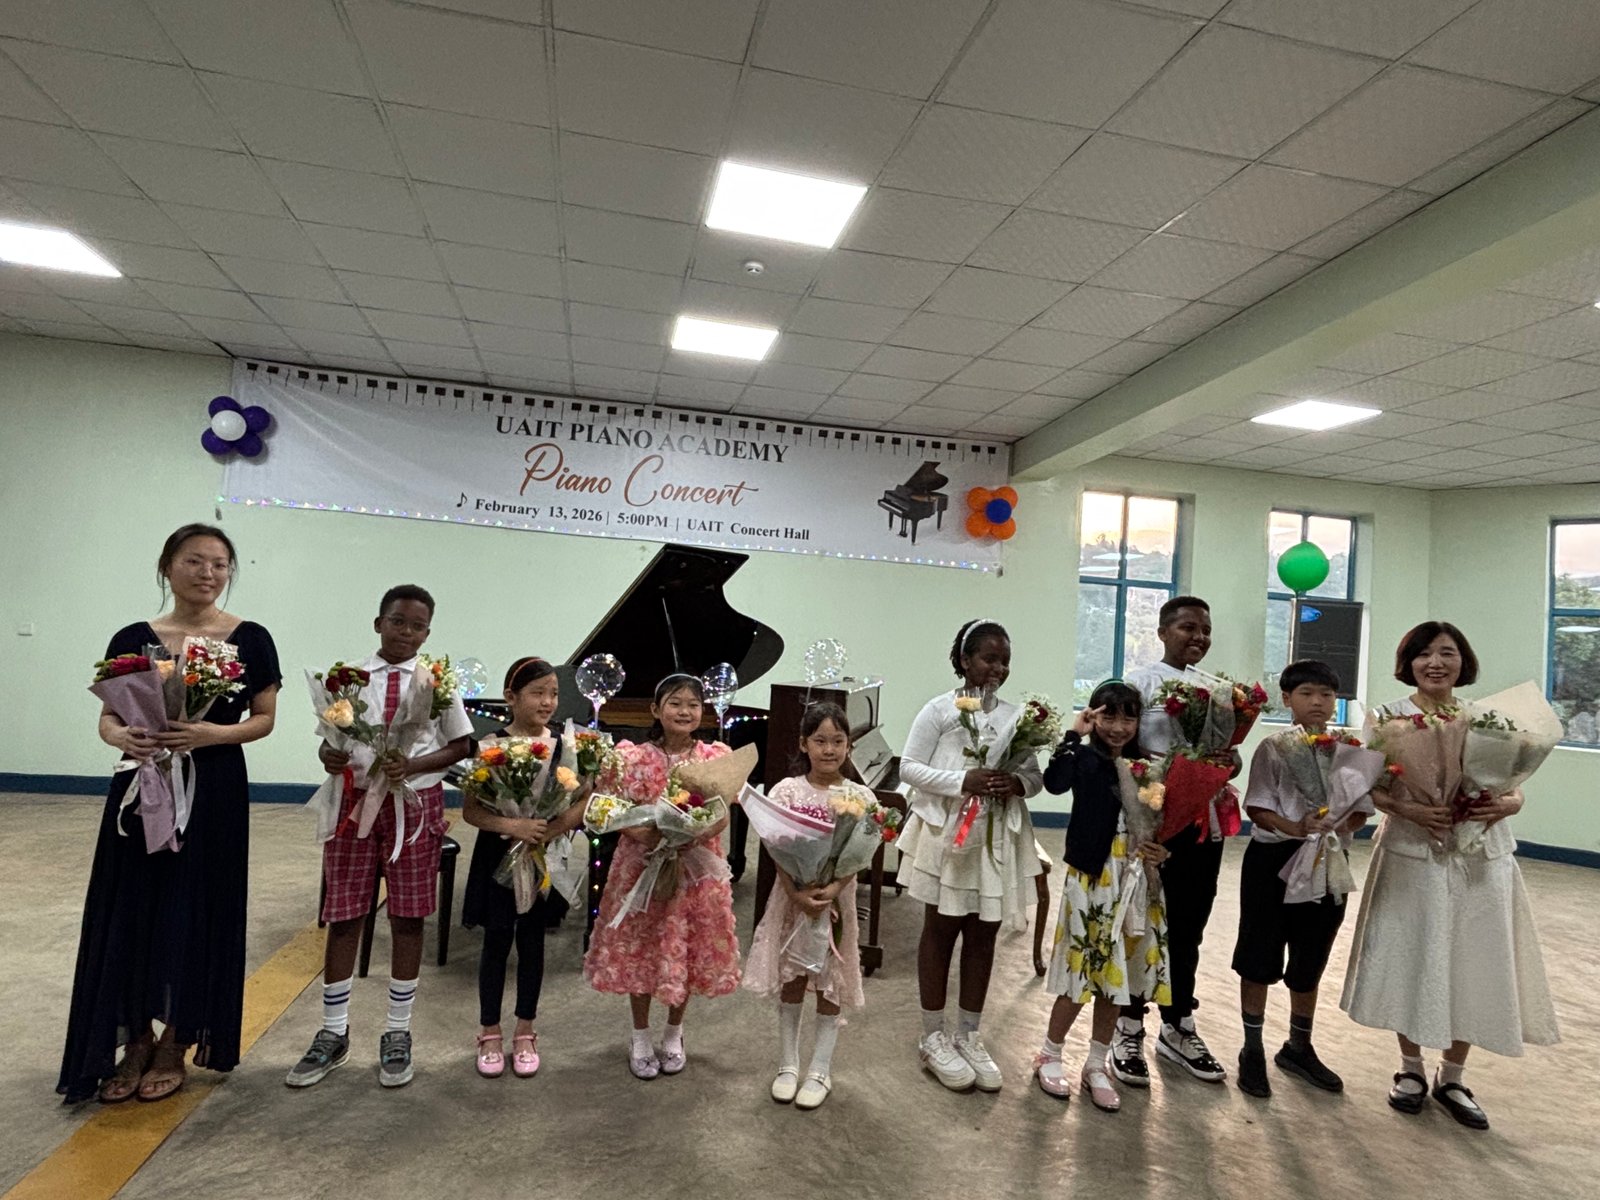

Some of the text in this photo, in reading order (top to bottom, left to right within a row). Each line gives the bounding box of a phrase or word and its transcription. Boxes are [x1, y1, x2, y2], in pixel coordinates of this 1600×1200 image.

[496, 415, 789, 463] UAIT PIANO ACADEMY
[520, 442, 760, 507] Piano Concert
[475, 498, 541, 519] February
[548, 505, 568, 521] 13,
[571, 507, 603, 522] 2026
[617, 512, 668, 528] 5:00PM
[687, 518, 724, 533] UAIT
[730, 523, 780, 538] Concert
[784, 527, 810, 541] Hall
